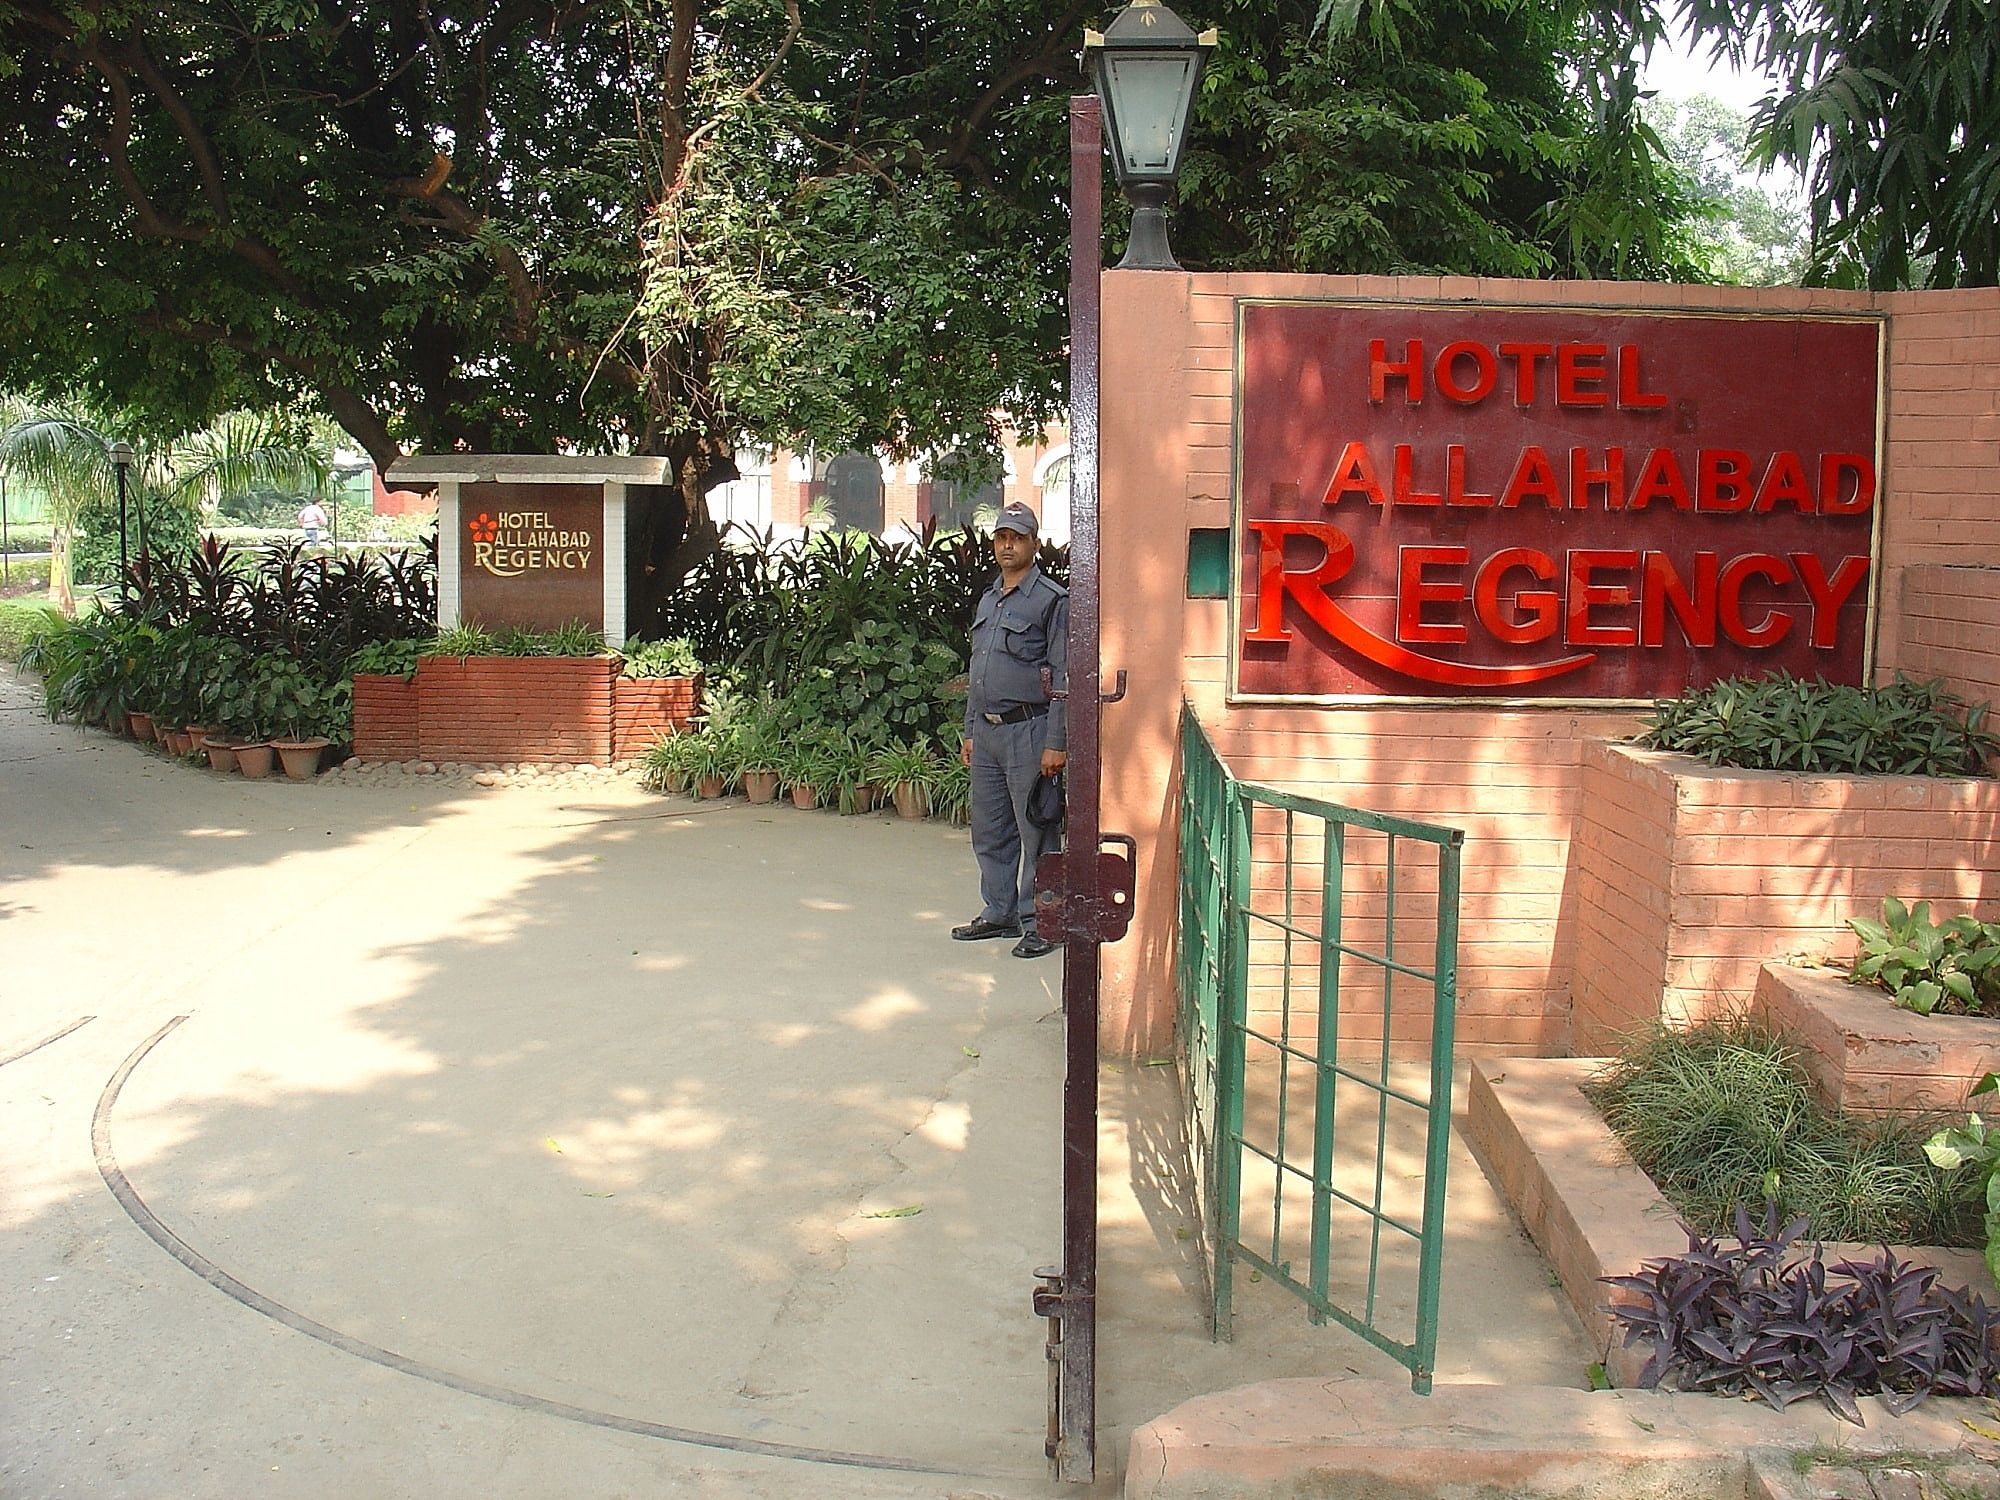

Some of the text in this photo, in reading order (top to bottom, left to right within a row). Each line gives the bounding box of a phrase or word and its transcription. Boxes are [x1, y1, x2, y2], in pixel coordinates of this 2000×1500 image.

[1368, 338, 1667, 410] HOTEL
[1322, 442, 1876, 515] ALLAHABAD
[494, 531, 591, 548] ALLAHABAD
[498, 512, 554, 529] HOTEL
[473, 542, 592, 577] REGENCY
[1245, 518, 1871, 687] REGENCY
